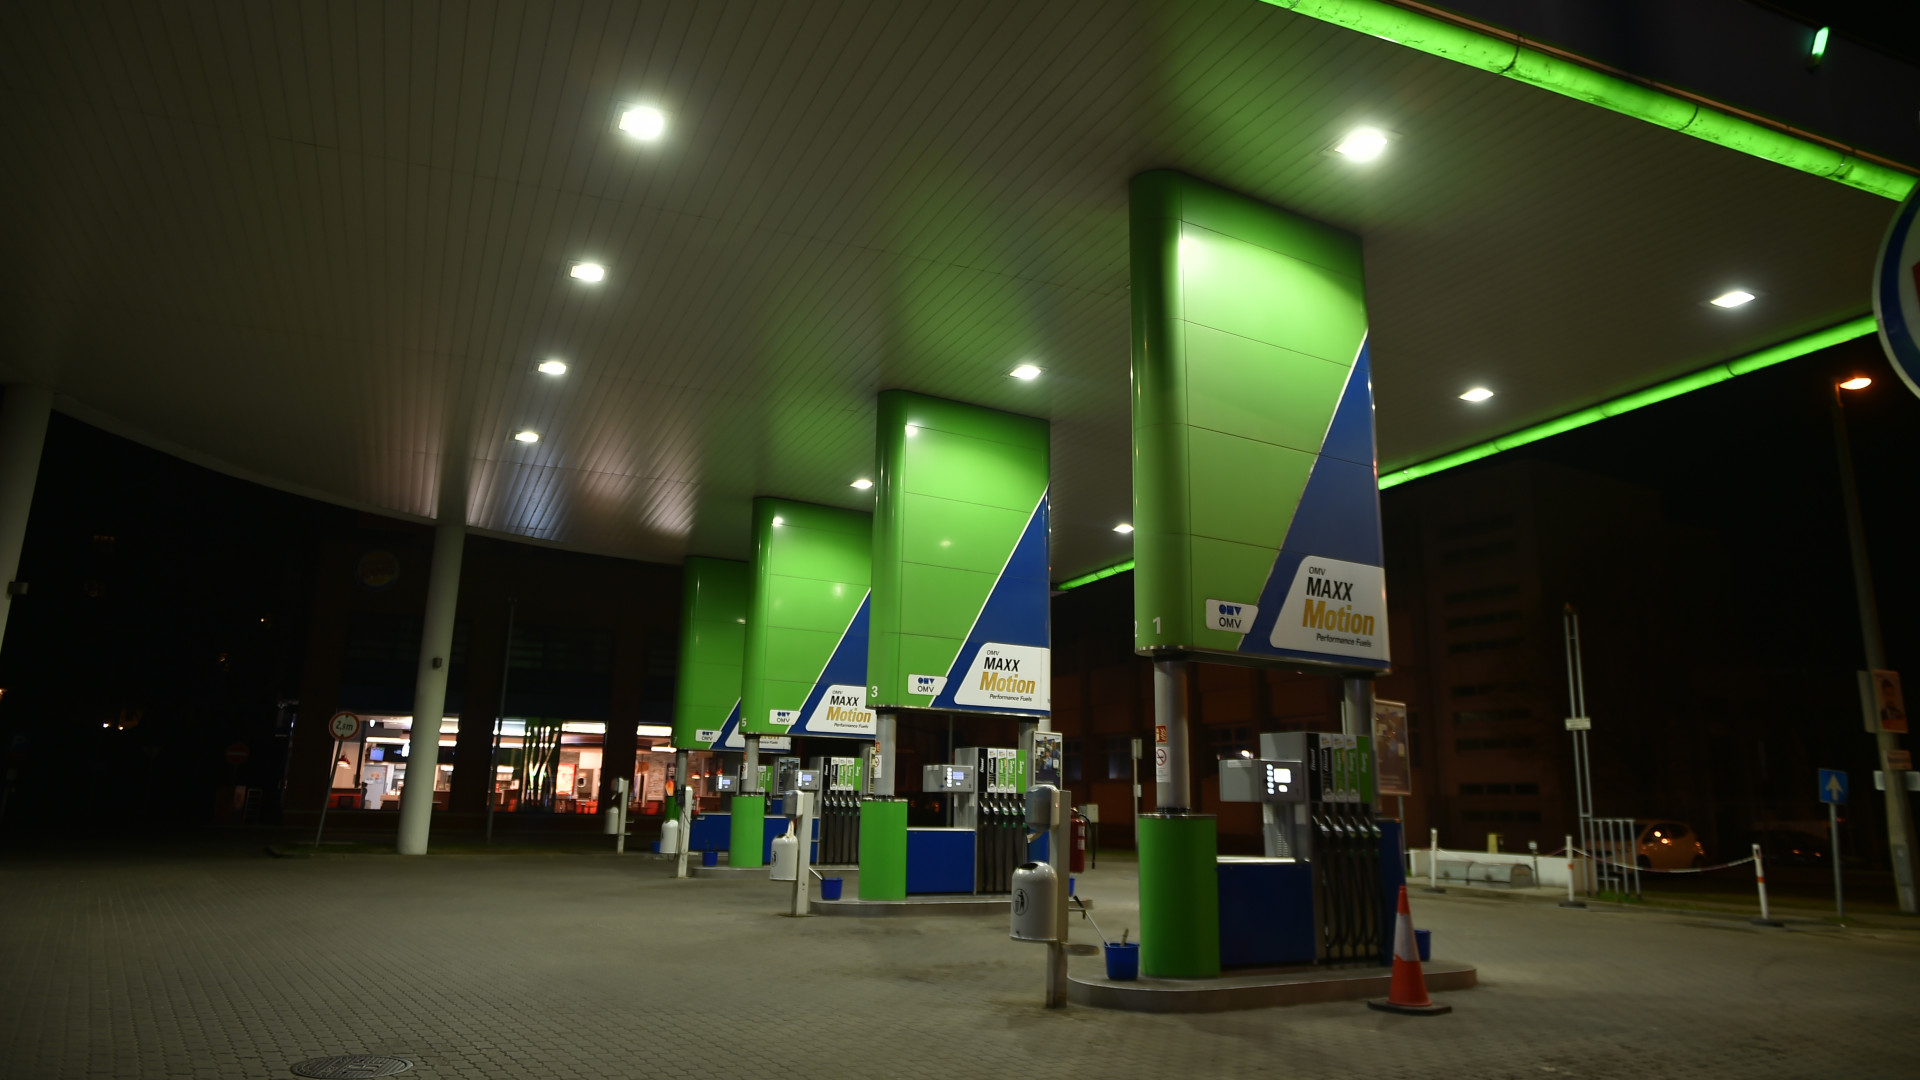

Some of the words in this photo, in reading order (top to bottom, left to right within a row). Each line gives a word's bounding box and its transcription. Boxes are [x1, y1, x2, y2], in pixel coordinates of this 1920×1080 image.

[1308, 566, 1326, 576] OMV
[1306, 576, 1353, 602] MAXX
[1218, 616, 1242, 629] OMV
[1302, 598, 1375, 636] Motion
[1152, 616, 1161, 635] 1
[1316, 632, 1355, 646] Performance
[983, 656, 1020, 672] MAXX
[917, 685, 935, 693] OMV
[979, 671, 1036, 694] Motion
[871, 685, 879, 698] 3
[989, 693, 1019, 701] Performance
[830, 695, 859, 706] MAXX
[826, 706, 872, 723] Motion
[741, 717, 747, 727] 5
